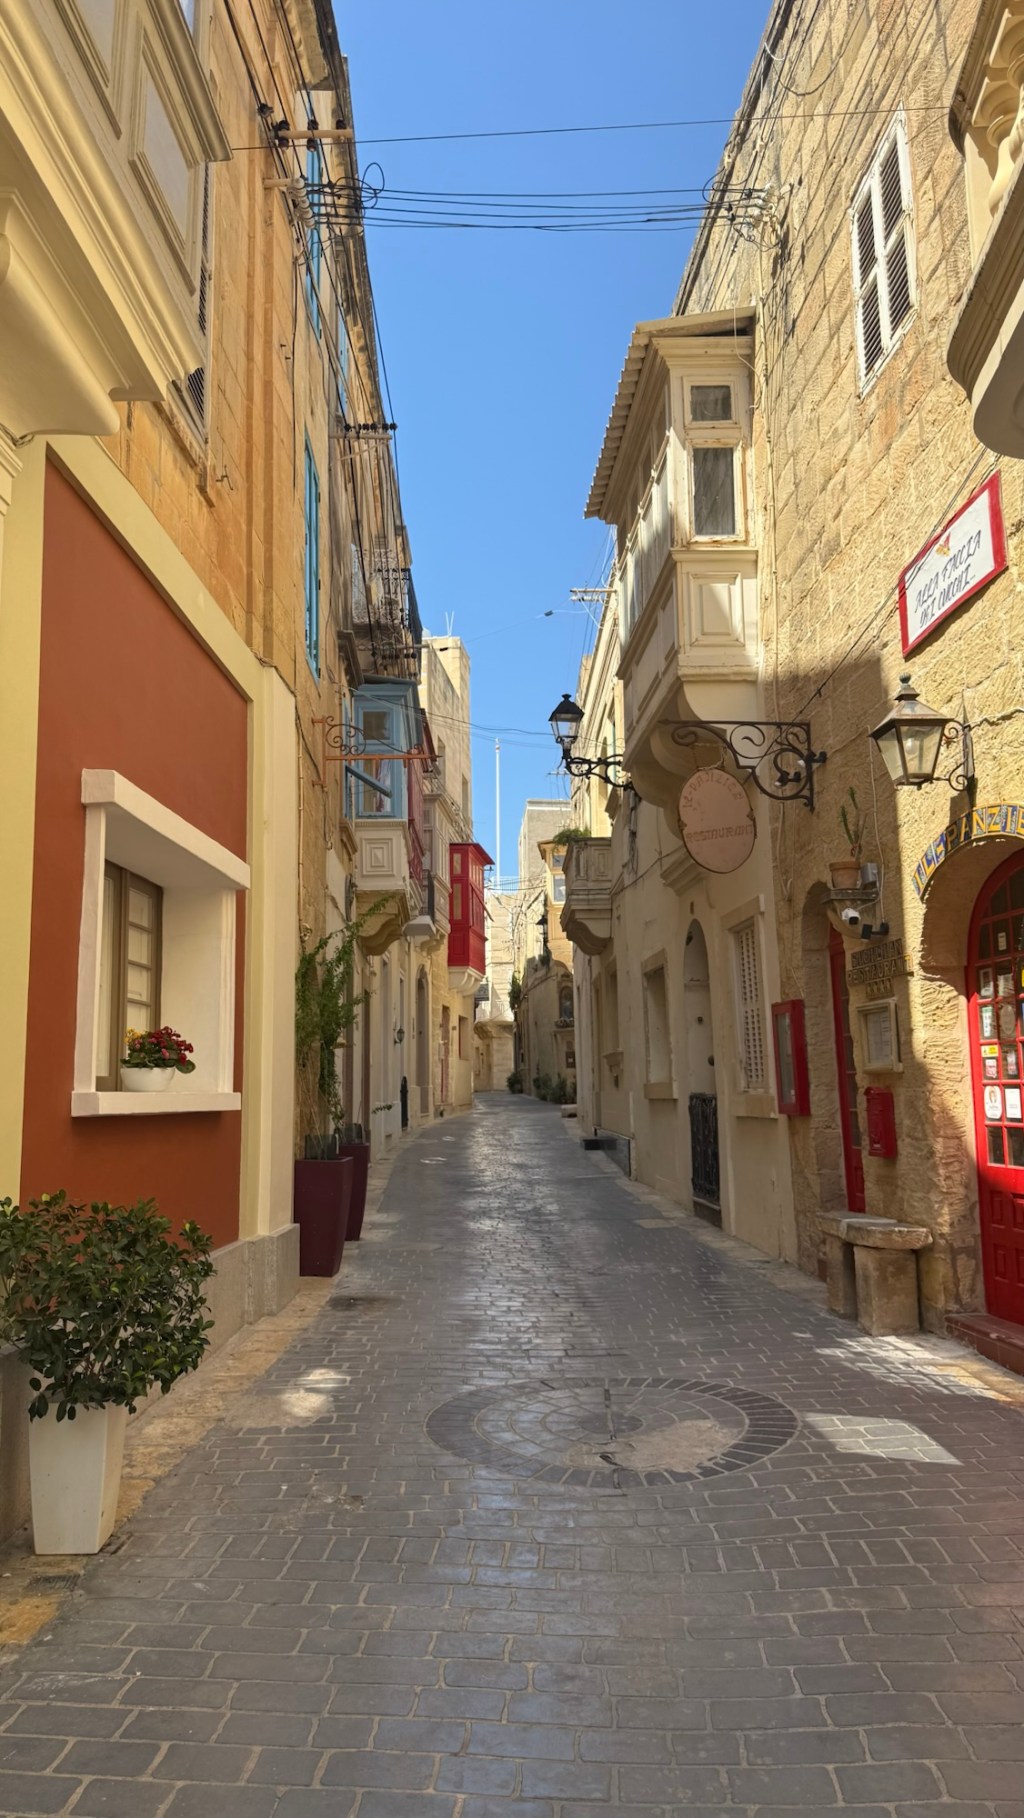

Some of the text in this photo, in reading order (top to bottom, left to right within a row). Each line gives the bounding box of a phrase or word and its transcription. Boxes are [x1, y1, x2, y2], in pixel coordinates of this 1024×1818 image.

[914, 571, 939, 613] ALLA
[686, 824, 753, 843] RESTAURANT
[847, 953, 913, 984] RESTAURANT
